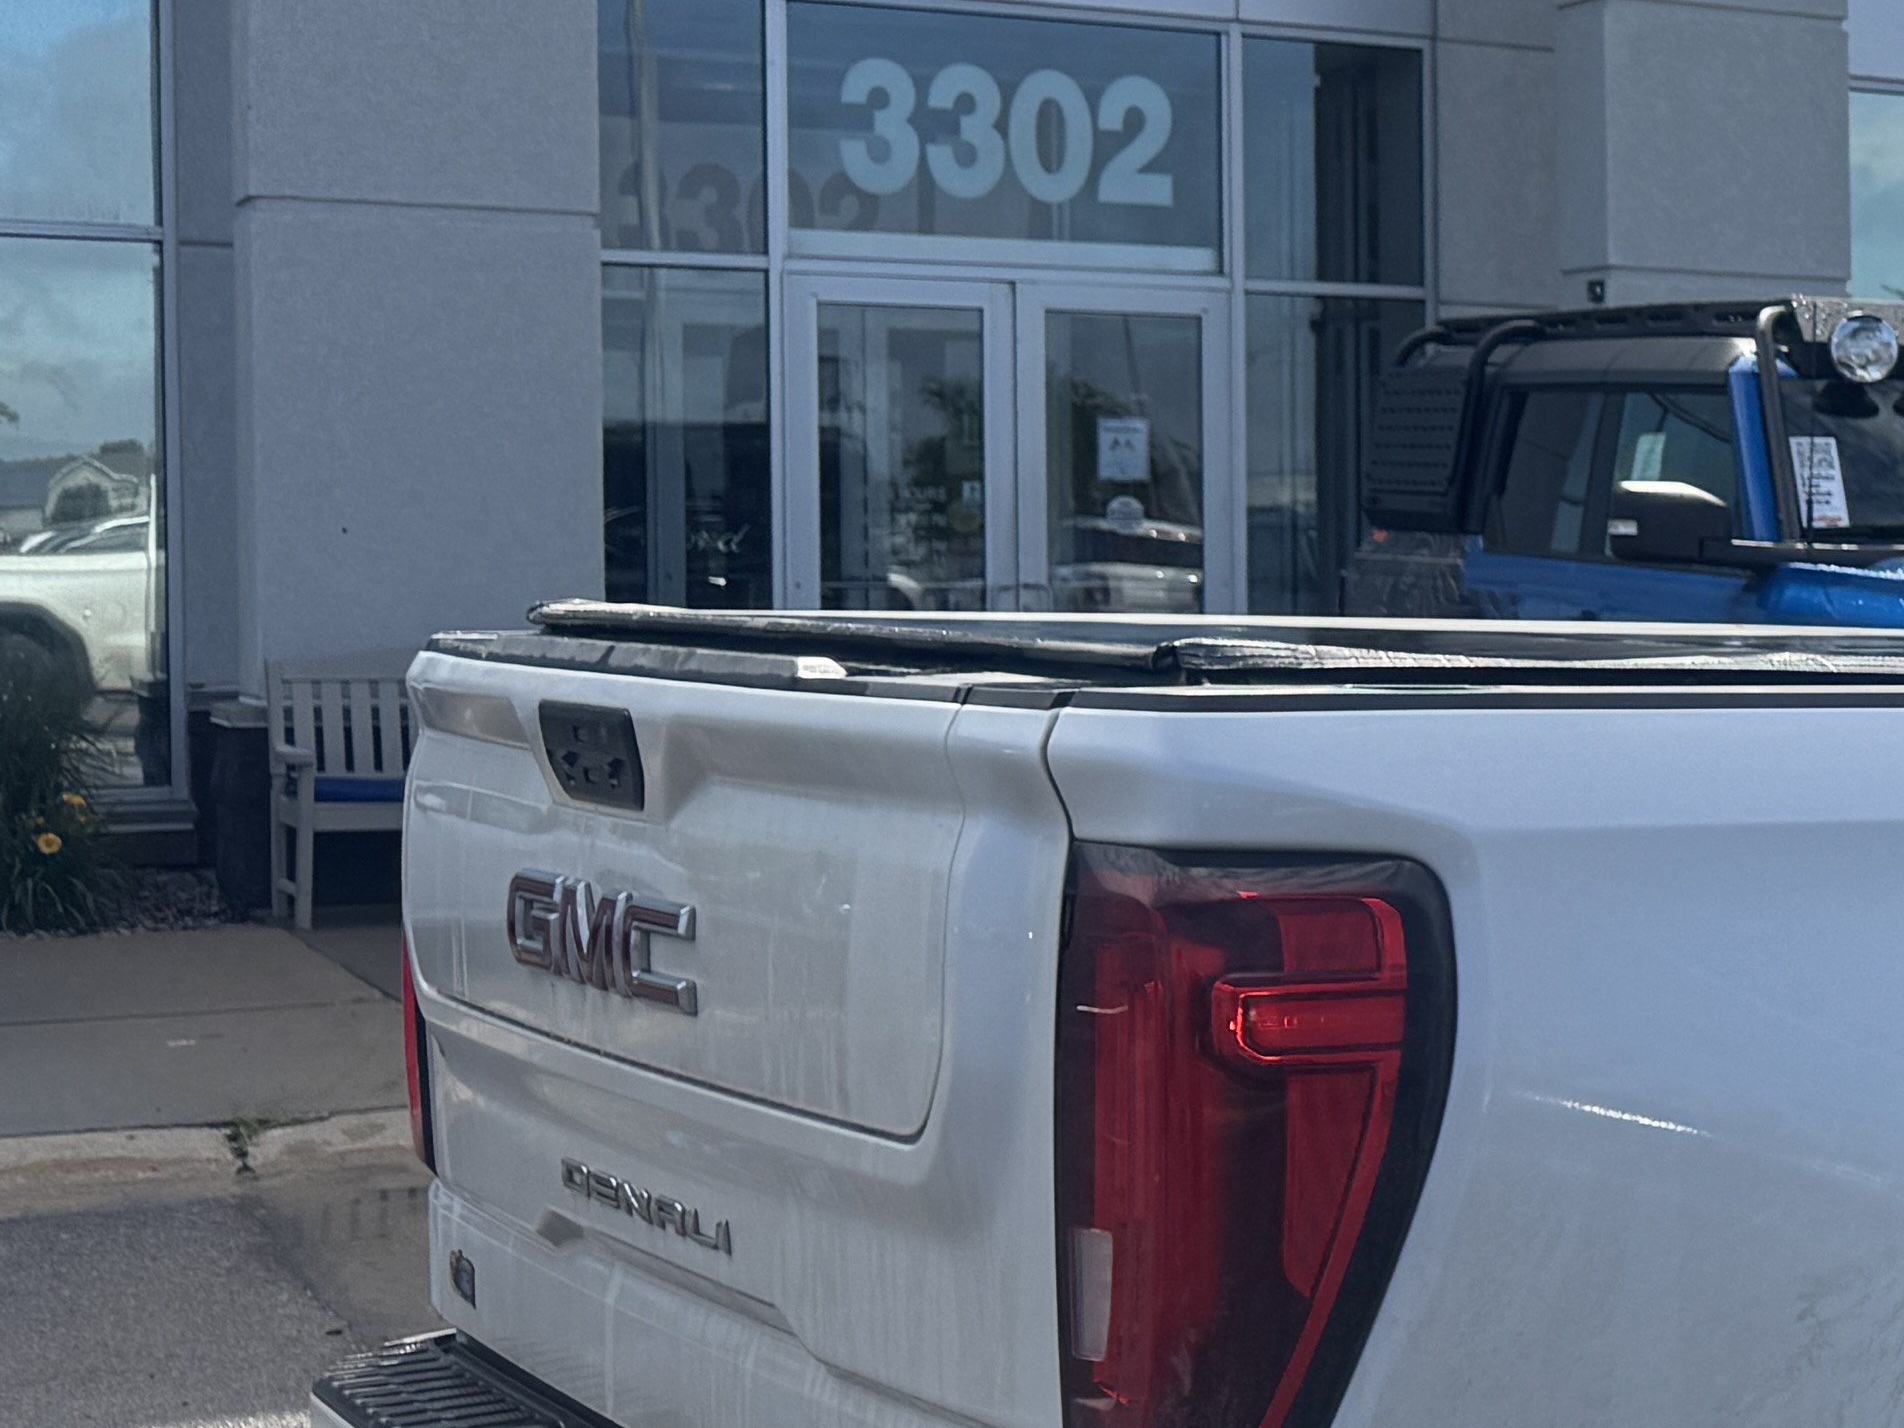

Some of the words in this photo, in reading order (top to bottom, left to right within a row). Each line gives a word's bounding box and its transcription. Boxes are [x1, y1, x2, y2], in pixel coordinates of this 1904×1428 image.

[840, 58, 1175, 207] 3302
[506, 871, 698, 1017] GMC
[560, 1156, 733, 1257] DENALI
